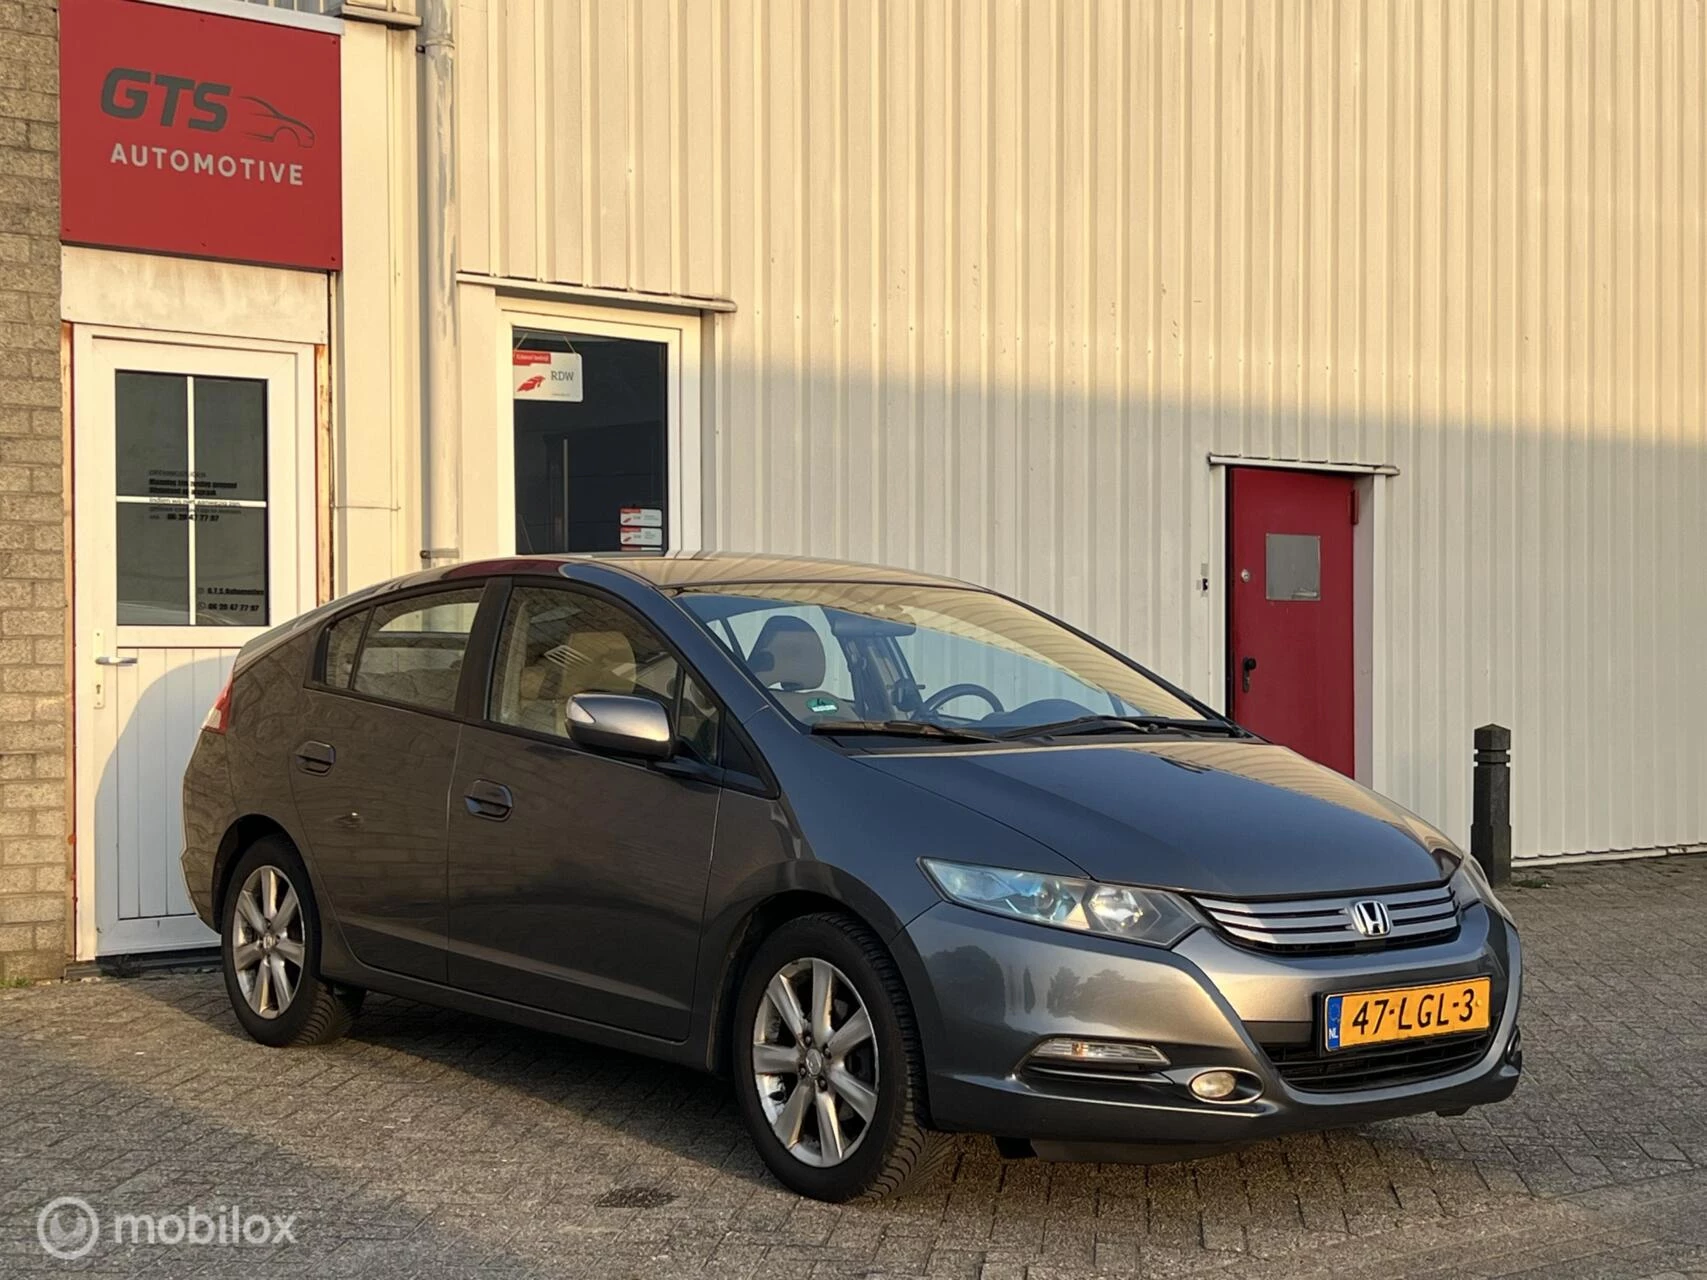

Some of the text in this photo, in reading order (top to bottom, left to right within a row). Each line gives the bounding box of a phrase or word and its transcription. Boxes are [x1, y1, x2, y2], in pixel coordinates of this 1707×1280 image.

[100, 66, 232, 133] GTS
[110, 143, 304, 186] AUTOMOTIVE
[551, 370, 574, 381] RDW
[1328, 1027, 1339, 1040] NL
